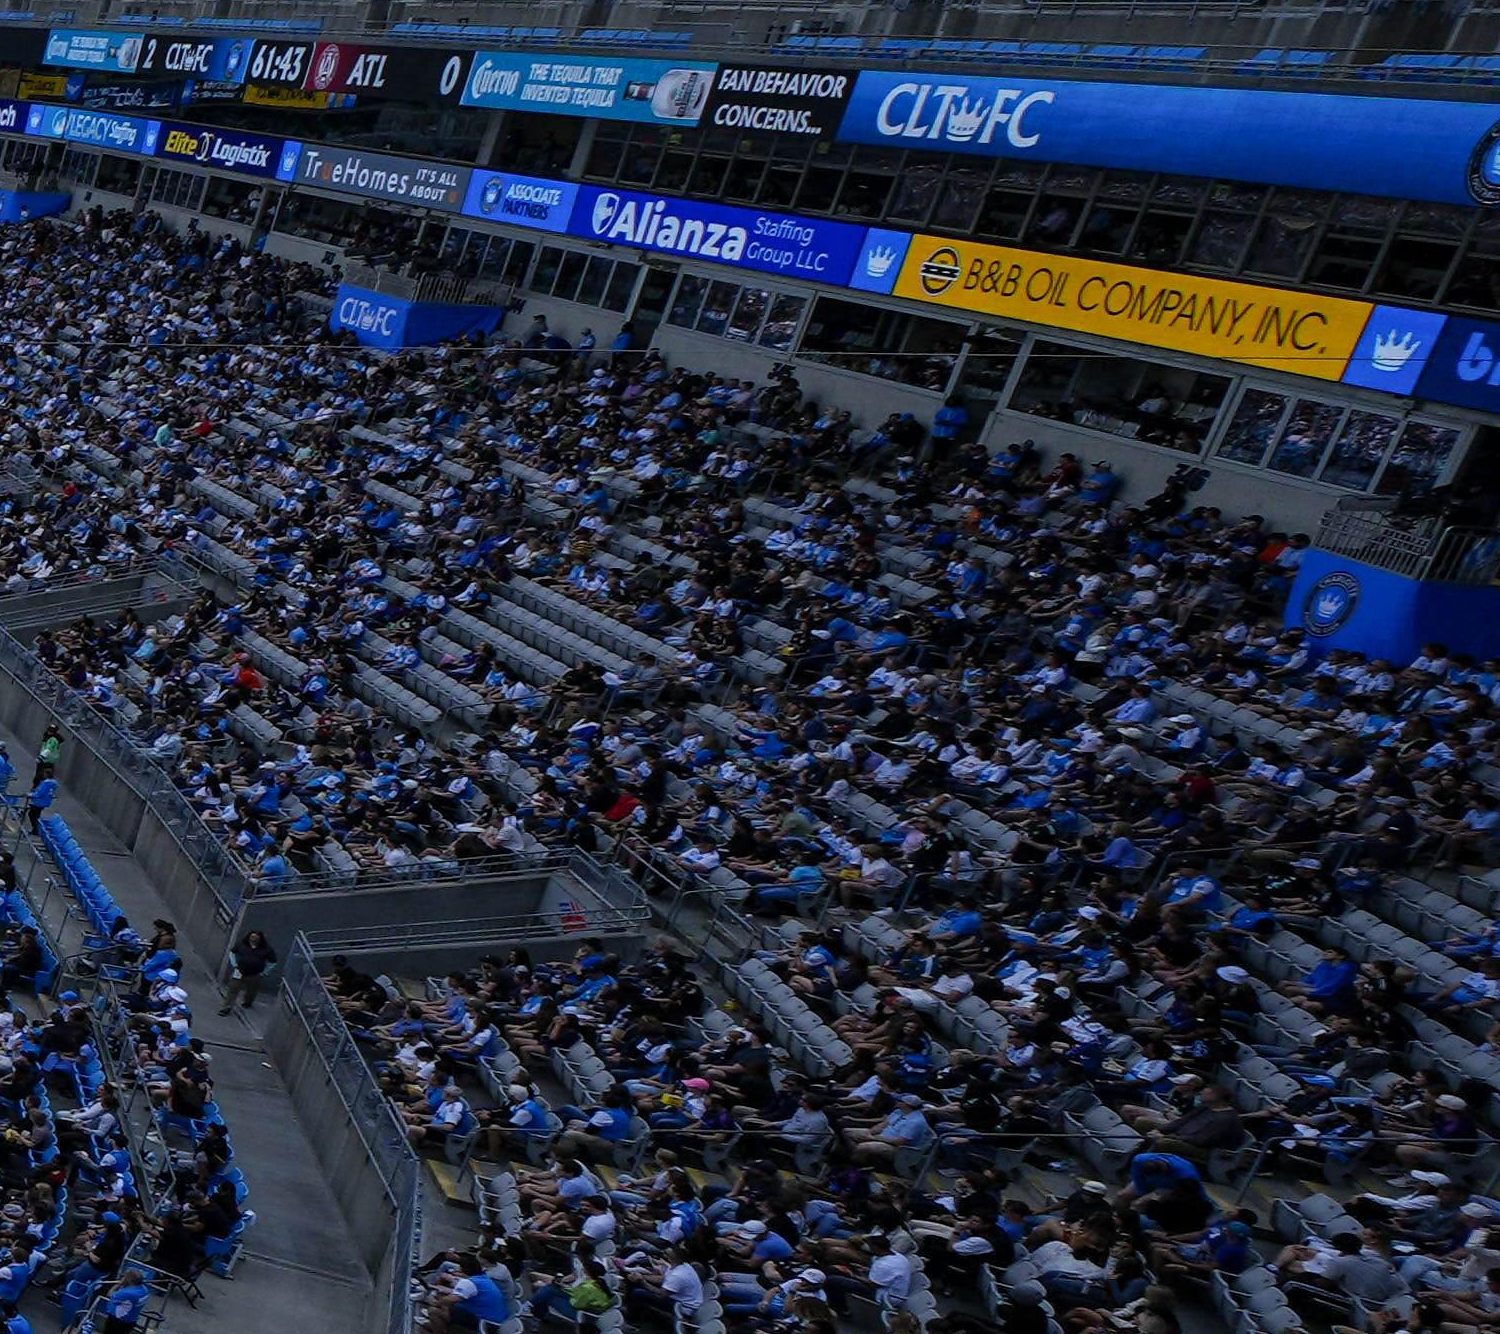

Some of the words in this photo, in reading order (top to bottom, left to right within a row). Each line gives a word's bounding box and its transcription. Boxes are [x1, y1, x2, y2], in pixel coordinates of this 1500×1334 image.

[143, 39, 157, 68] 2
[250, 40, 306, 81] 61:43
[345, 54, 388, 88] ATL
[439, 56, 461, 96] 0
[470, 59, 520, 99] Cuervo
[530, 63, 550, 81] THE
[550, 64, 591, 84] TEQUILA
[592, 67, 622, 86] THAT
[717, 68, 752, 91] FAN
[753, 71, 847, 100] BEHAVIOR
[520, 82, 567, 103] INVENTED
[568, 85, 617, 108] TEQUILA
[68, 110, 110, 142] LEGACY
[164, 130, 198, 155] Elite
[211, 137, 272, 169] Logistix
[415, 168, 437, 183] IT'S
[437, 171, 457, 186] ALL
[409, 186, 446, 202] ABOUT
[504, 183, 560, 206] ASSOCIATE
[501, 201, 550, 221] PARTNERS
[613, 201, 749, 262] Alianza
[753, 217, 815, 246] Staffing
[746, 243, 793, 271] Group
[794, 250, 829, 273] LLC
[962, 257, 1019, 300] B&B
[1025, 267, 1070, 307] OIL
[1076, 275, 1247, 346] COMPANY,
[1252, 306, 1327, 355] INC.
